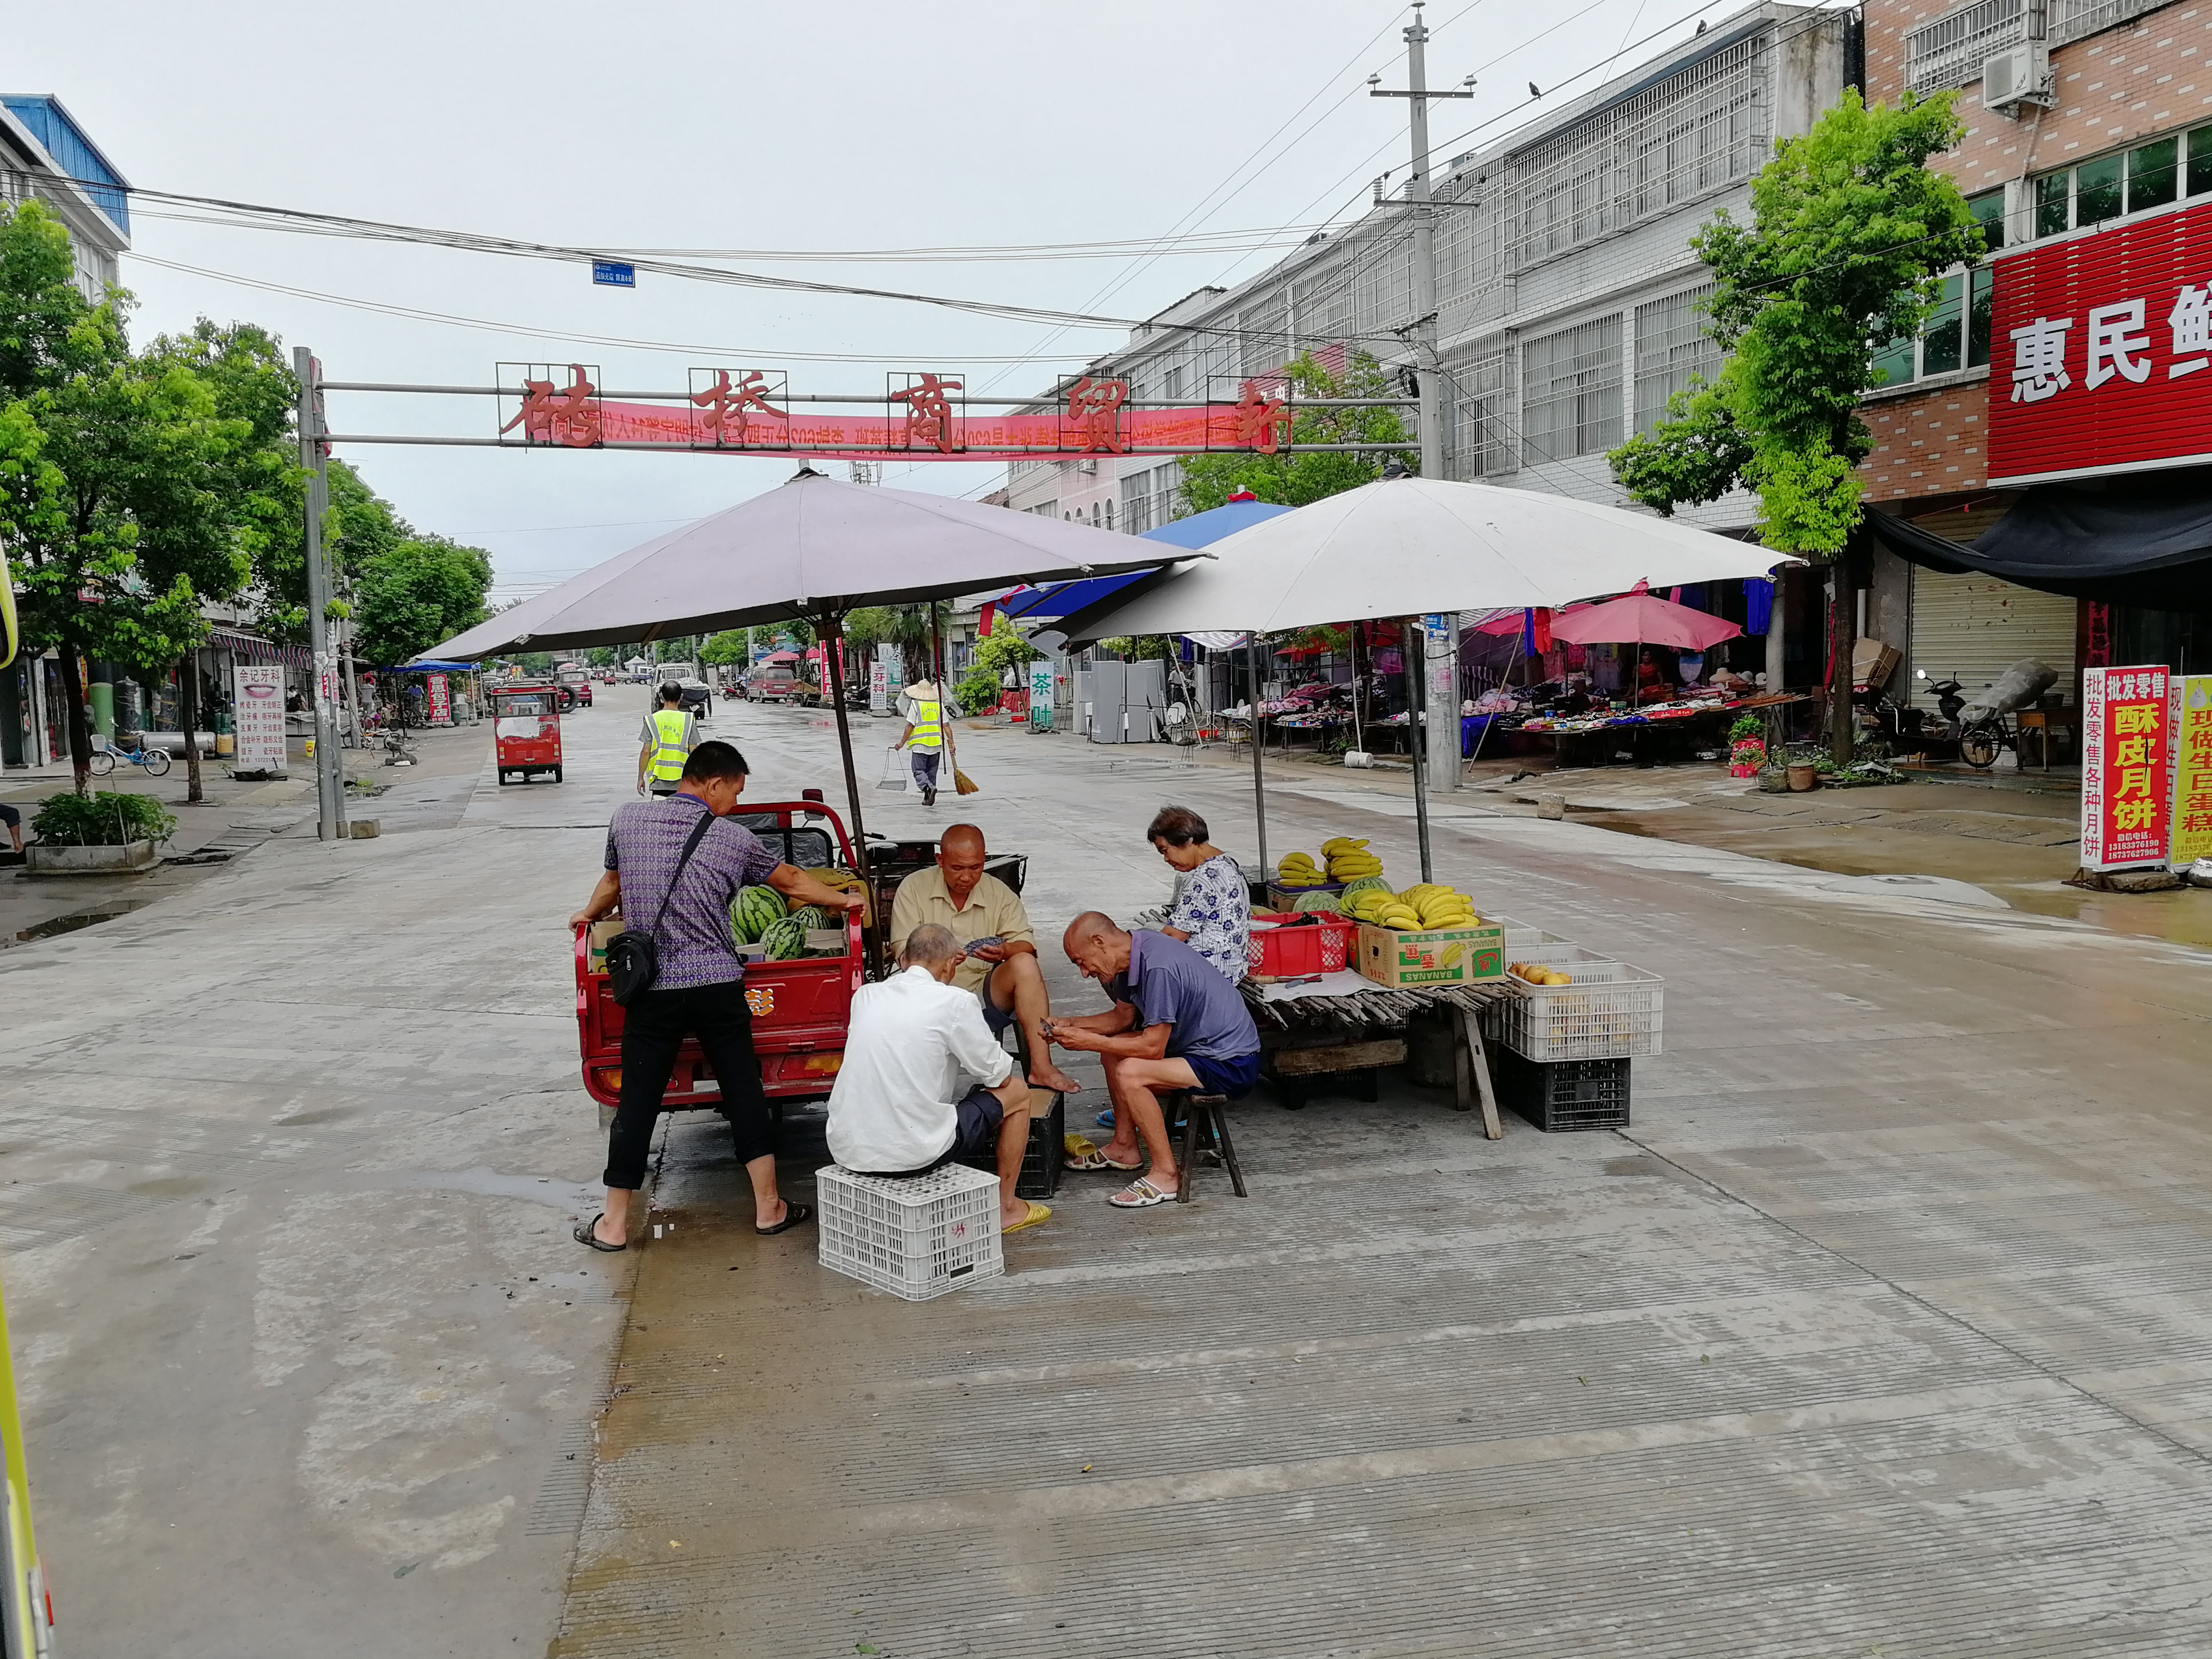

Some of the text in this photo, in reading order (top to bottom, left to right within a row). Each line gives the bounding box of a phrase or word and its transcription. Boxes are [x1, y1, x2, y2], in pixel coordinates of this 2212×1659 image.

[239, 669, 280, 683] 余记牙科
[873, 673, 885, 693] 牙科
[2107, 672, 2165, 702] 批发零售
[1032, 673, 1052, 725] 茶叶
[263, 724, 282, 732] 牙齿美容
[241, 736, 261, 744] 合金补牙
[2084, 674, 2103, 858] 批发零售各种月饼
[2113, 703, 2160, 830] 酥皮月饼
[2108, 839, 2159, 851] 13183376190
[2108, 848, 2159, 860] 18737627906
[1468, 938, 1497, 949] BANANAS
[1405, 944, 1434, 969] 香蕉
[1405, 970, 1453, 982] BANANAS
